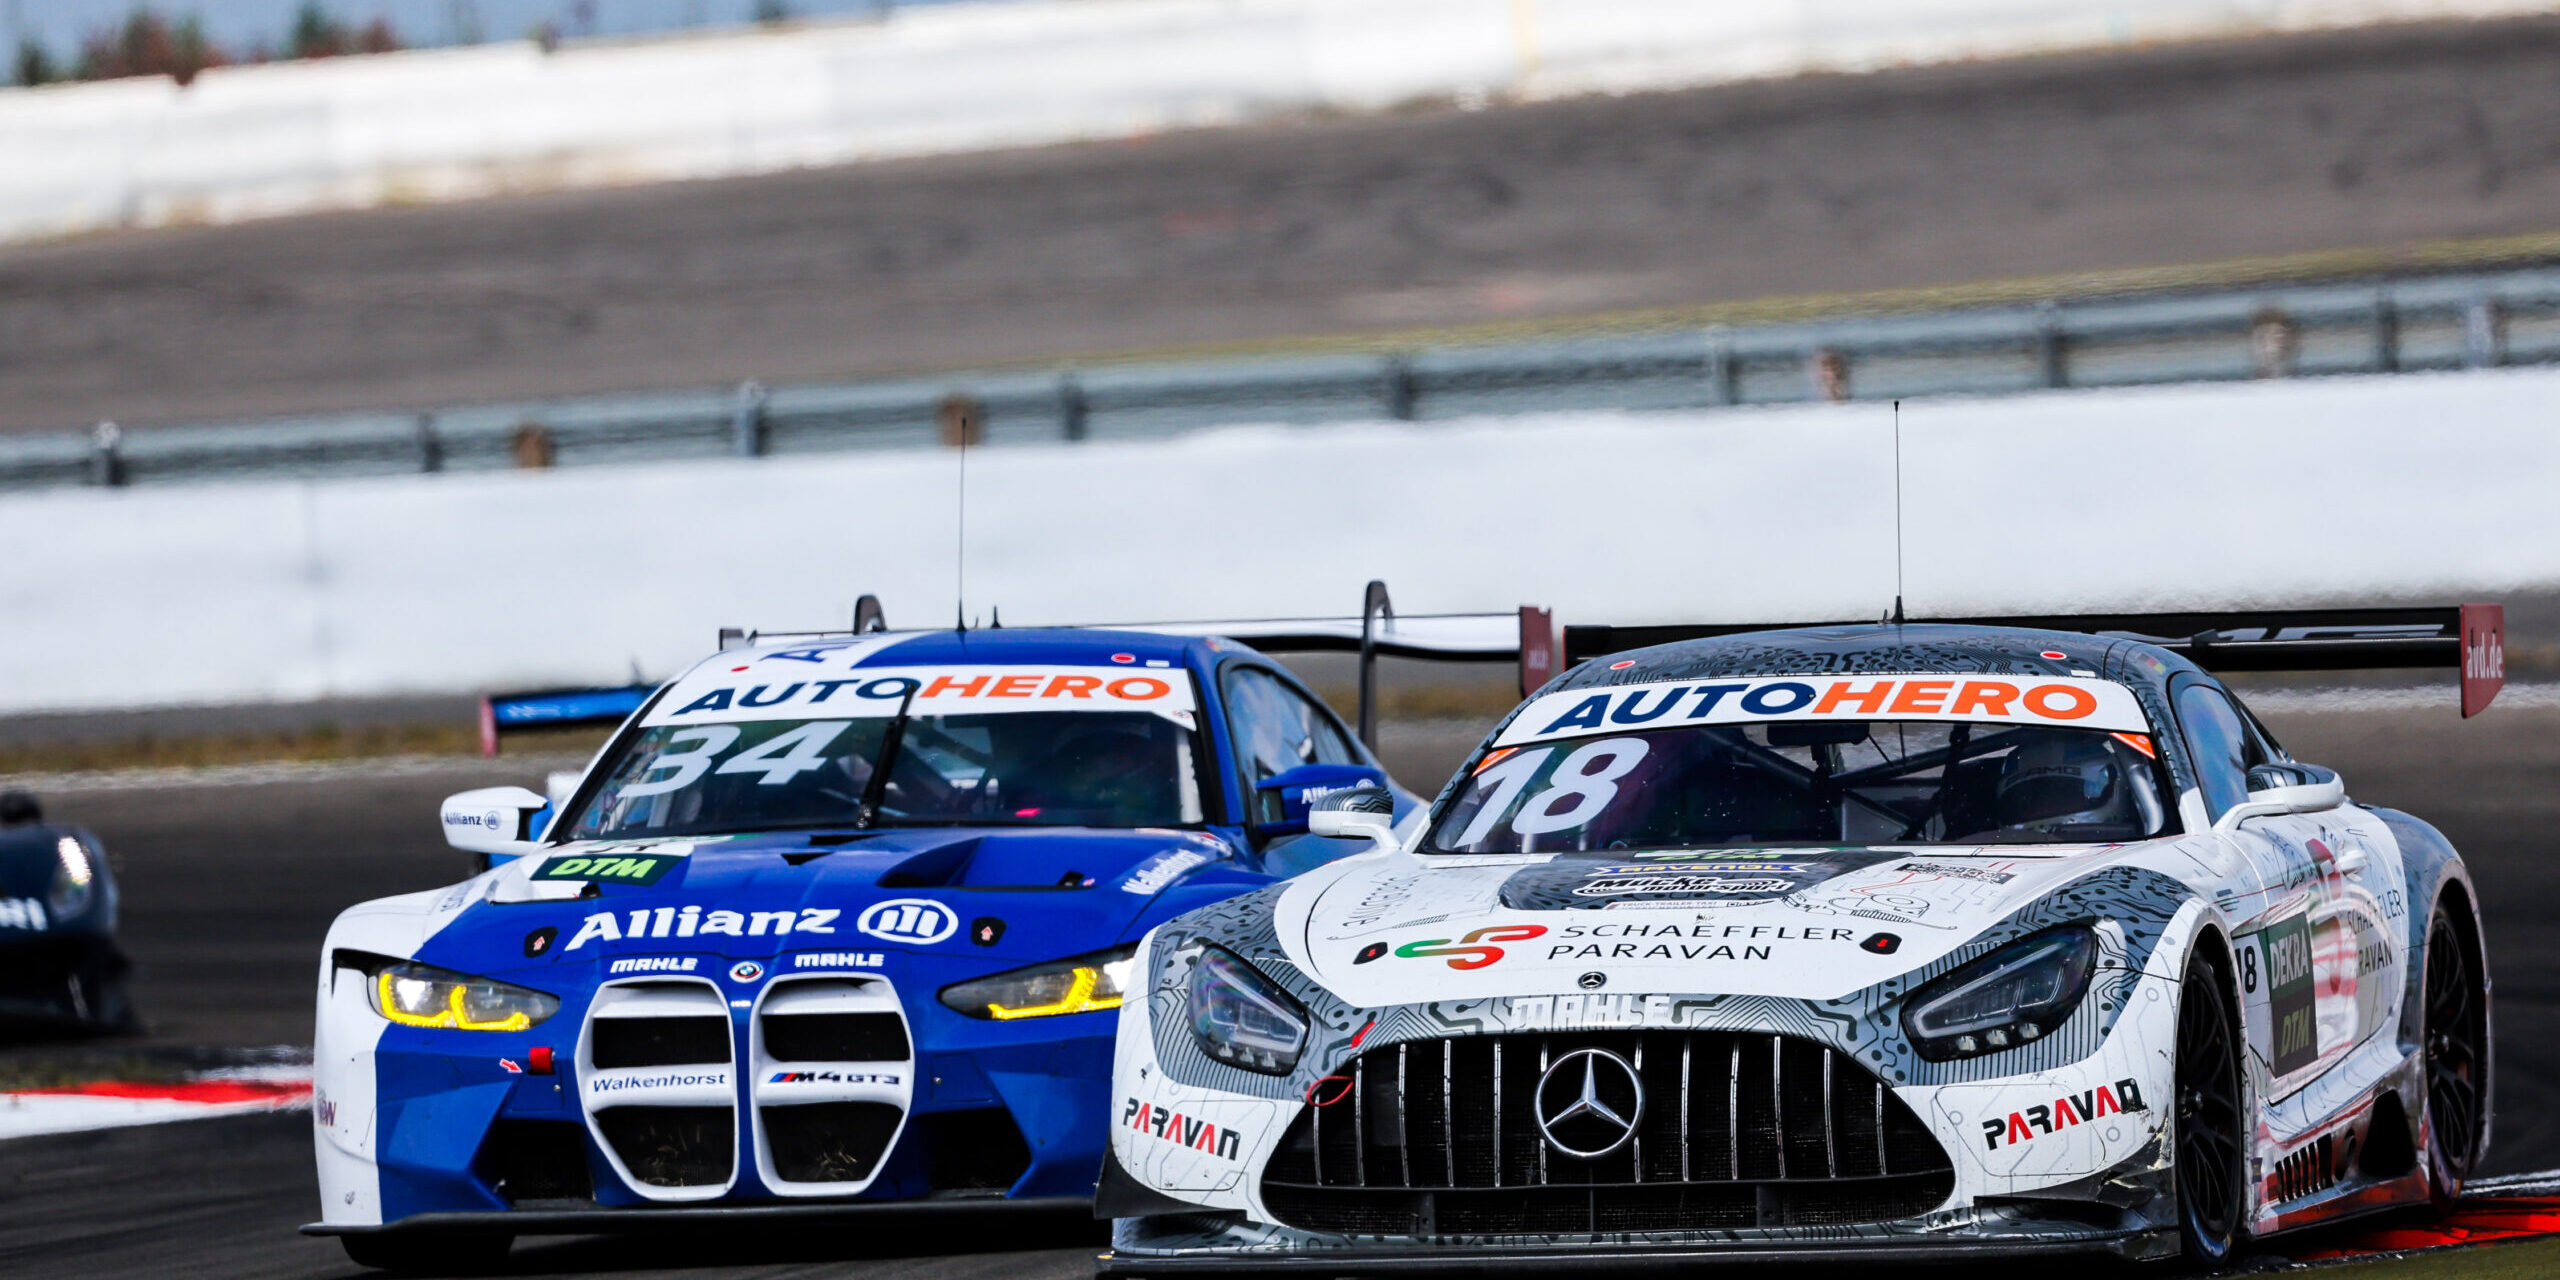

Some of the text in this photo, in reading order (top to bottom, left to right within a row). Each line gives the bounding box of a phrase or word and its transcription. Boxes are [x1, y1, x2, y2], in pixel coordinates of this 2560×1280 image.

[2467, 632, 2503, 679] avd.de
[669, 675, 1170, 716] AUTOHERO
[1534, 681, 2097, 735] AUTOHERO
[616, 724, 853, 798] 34
[1302, 786, 1354, 804] Alli
[1453, 738, 1649, 848] 18
[445, 812, 482, 826] Allianz
[549, 858, 657, 879] DTM
[1618, 864, 1782, 873] RAVENOL
[564, 905, 841, 951] Allianz
[1559, 924, 1854, 942] SCHAEFFLER
[610, 957, 698, 973] MAHLE
[795, 953, 884, 968] MAHLE
[1547, 944, 1772, 961] PARAVAN
[2269, 928, 2309, 990] DEKRA
[2356, 938, 2393, 978] RAVAN
[1511, 995, 1671, 1029] MAHLE
[2280, 1005, 2310, 1057] DTM
[593, 1073, 726, 1092] Walkenhorst
[847, 1073, 900, 1085] GT3
[1123, 1097, 1240, 1161] PARAVAN
[1982, 1078, 2147, 1151] PARAVAN
